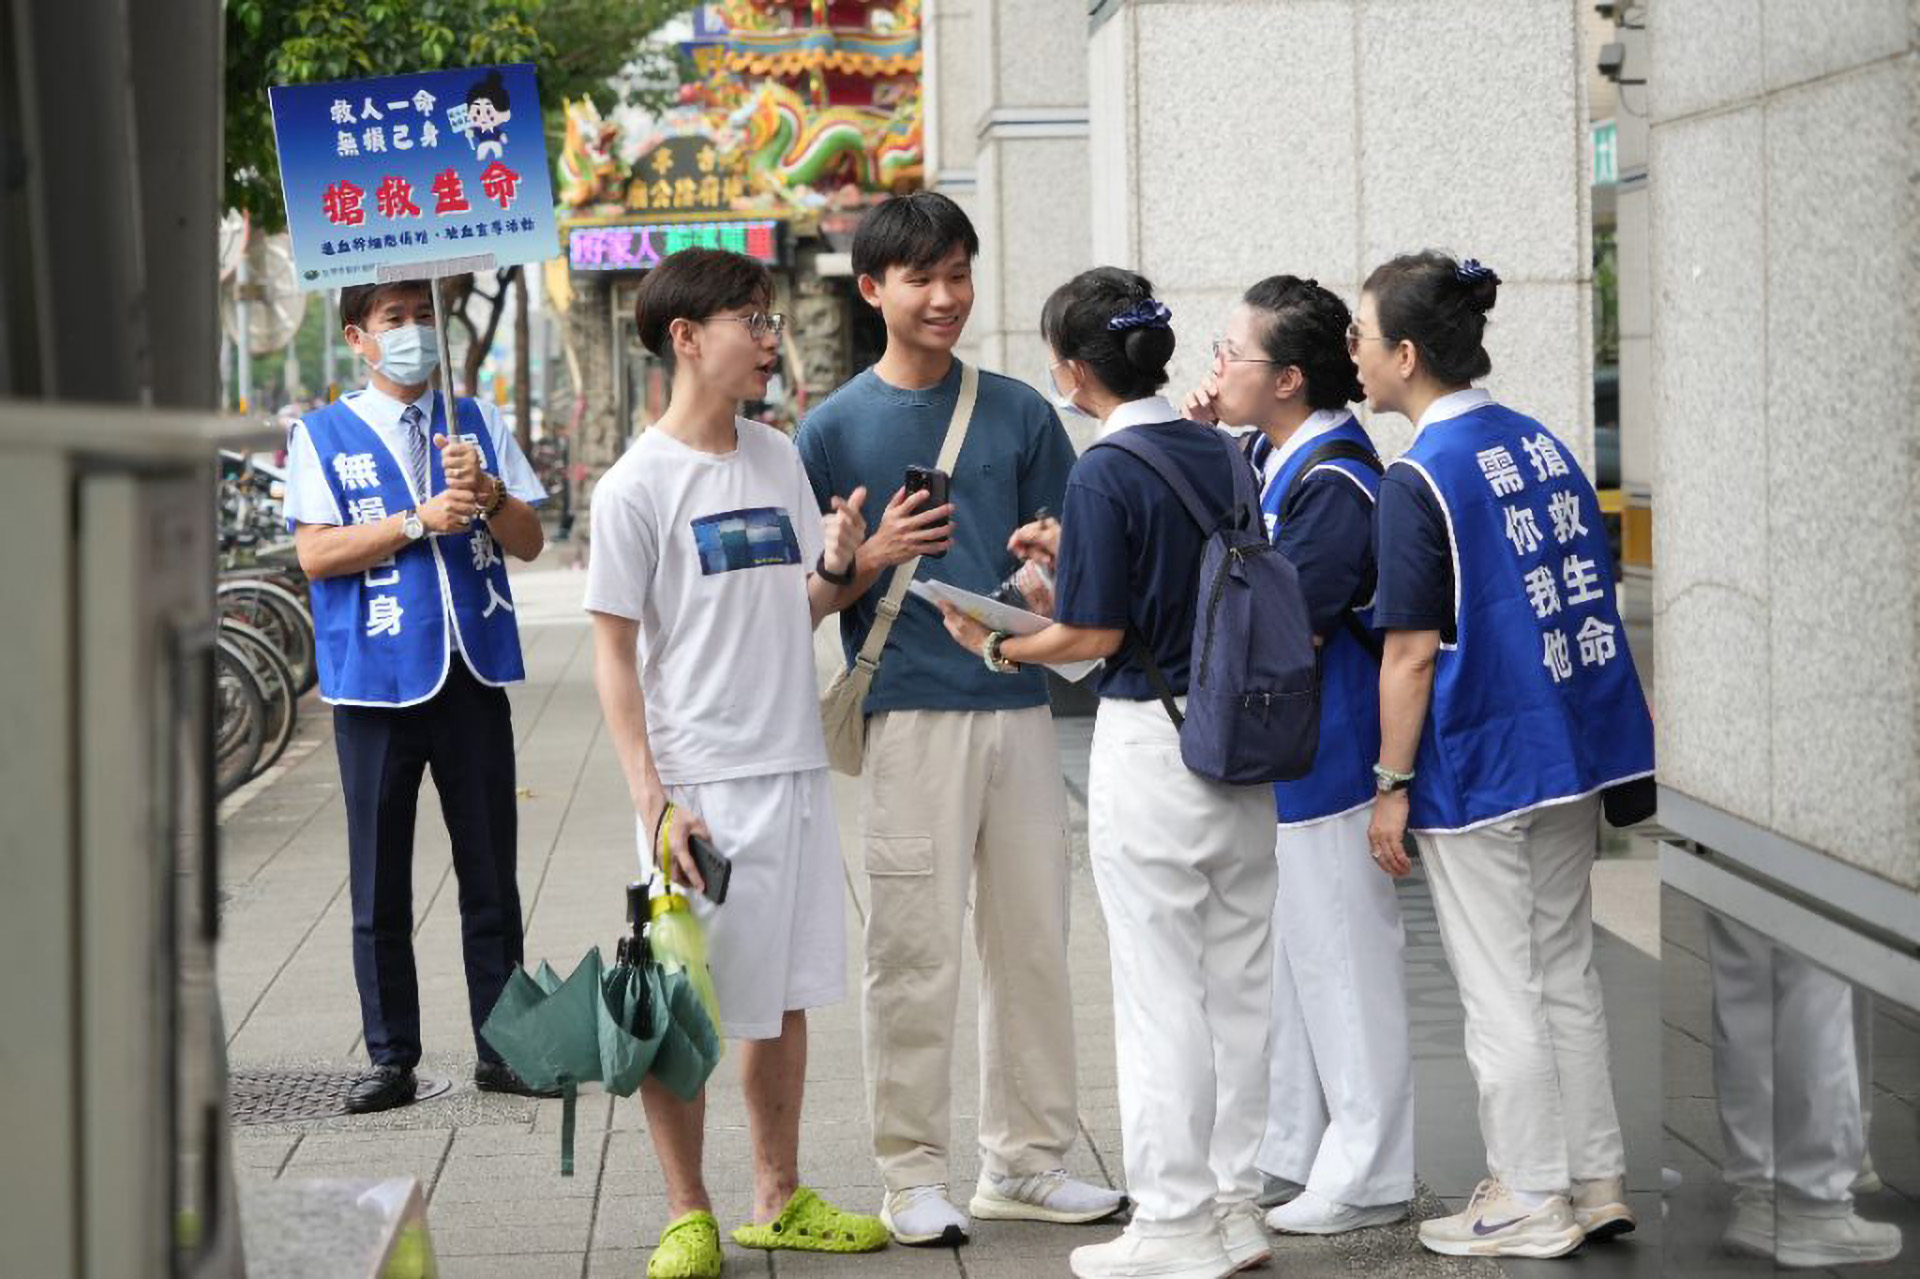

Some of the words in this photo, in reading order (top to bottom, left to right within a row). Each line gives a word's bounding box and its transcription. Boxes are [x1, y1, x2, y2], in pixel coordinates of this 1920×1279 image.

[330, 89, 436, 124] 救人一命
[337, 120, 439, 156] 無損己身
[322, 161, 522, 226] 搶救生命
[1476, 445, 1572, 683] 需你我他
[1521, 432, 1616, 667] 搶救生命
